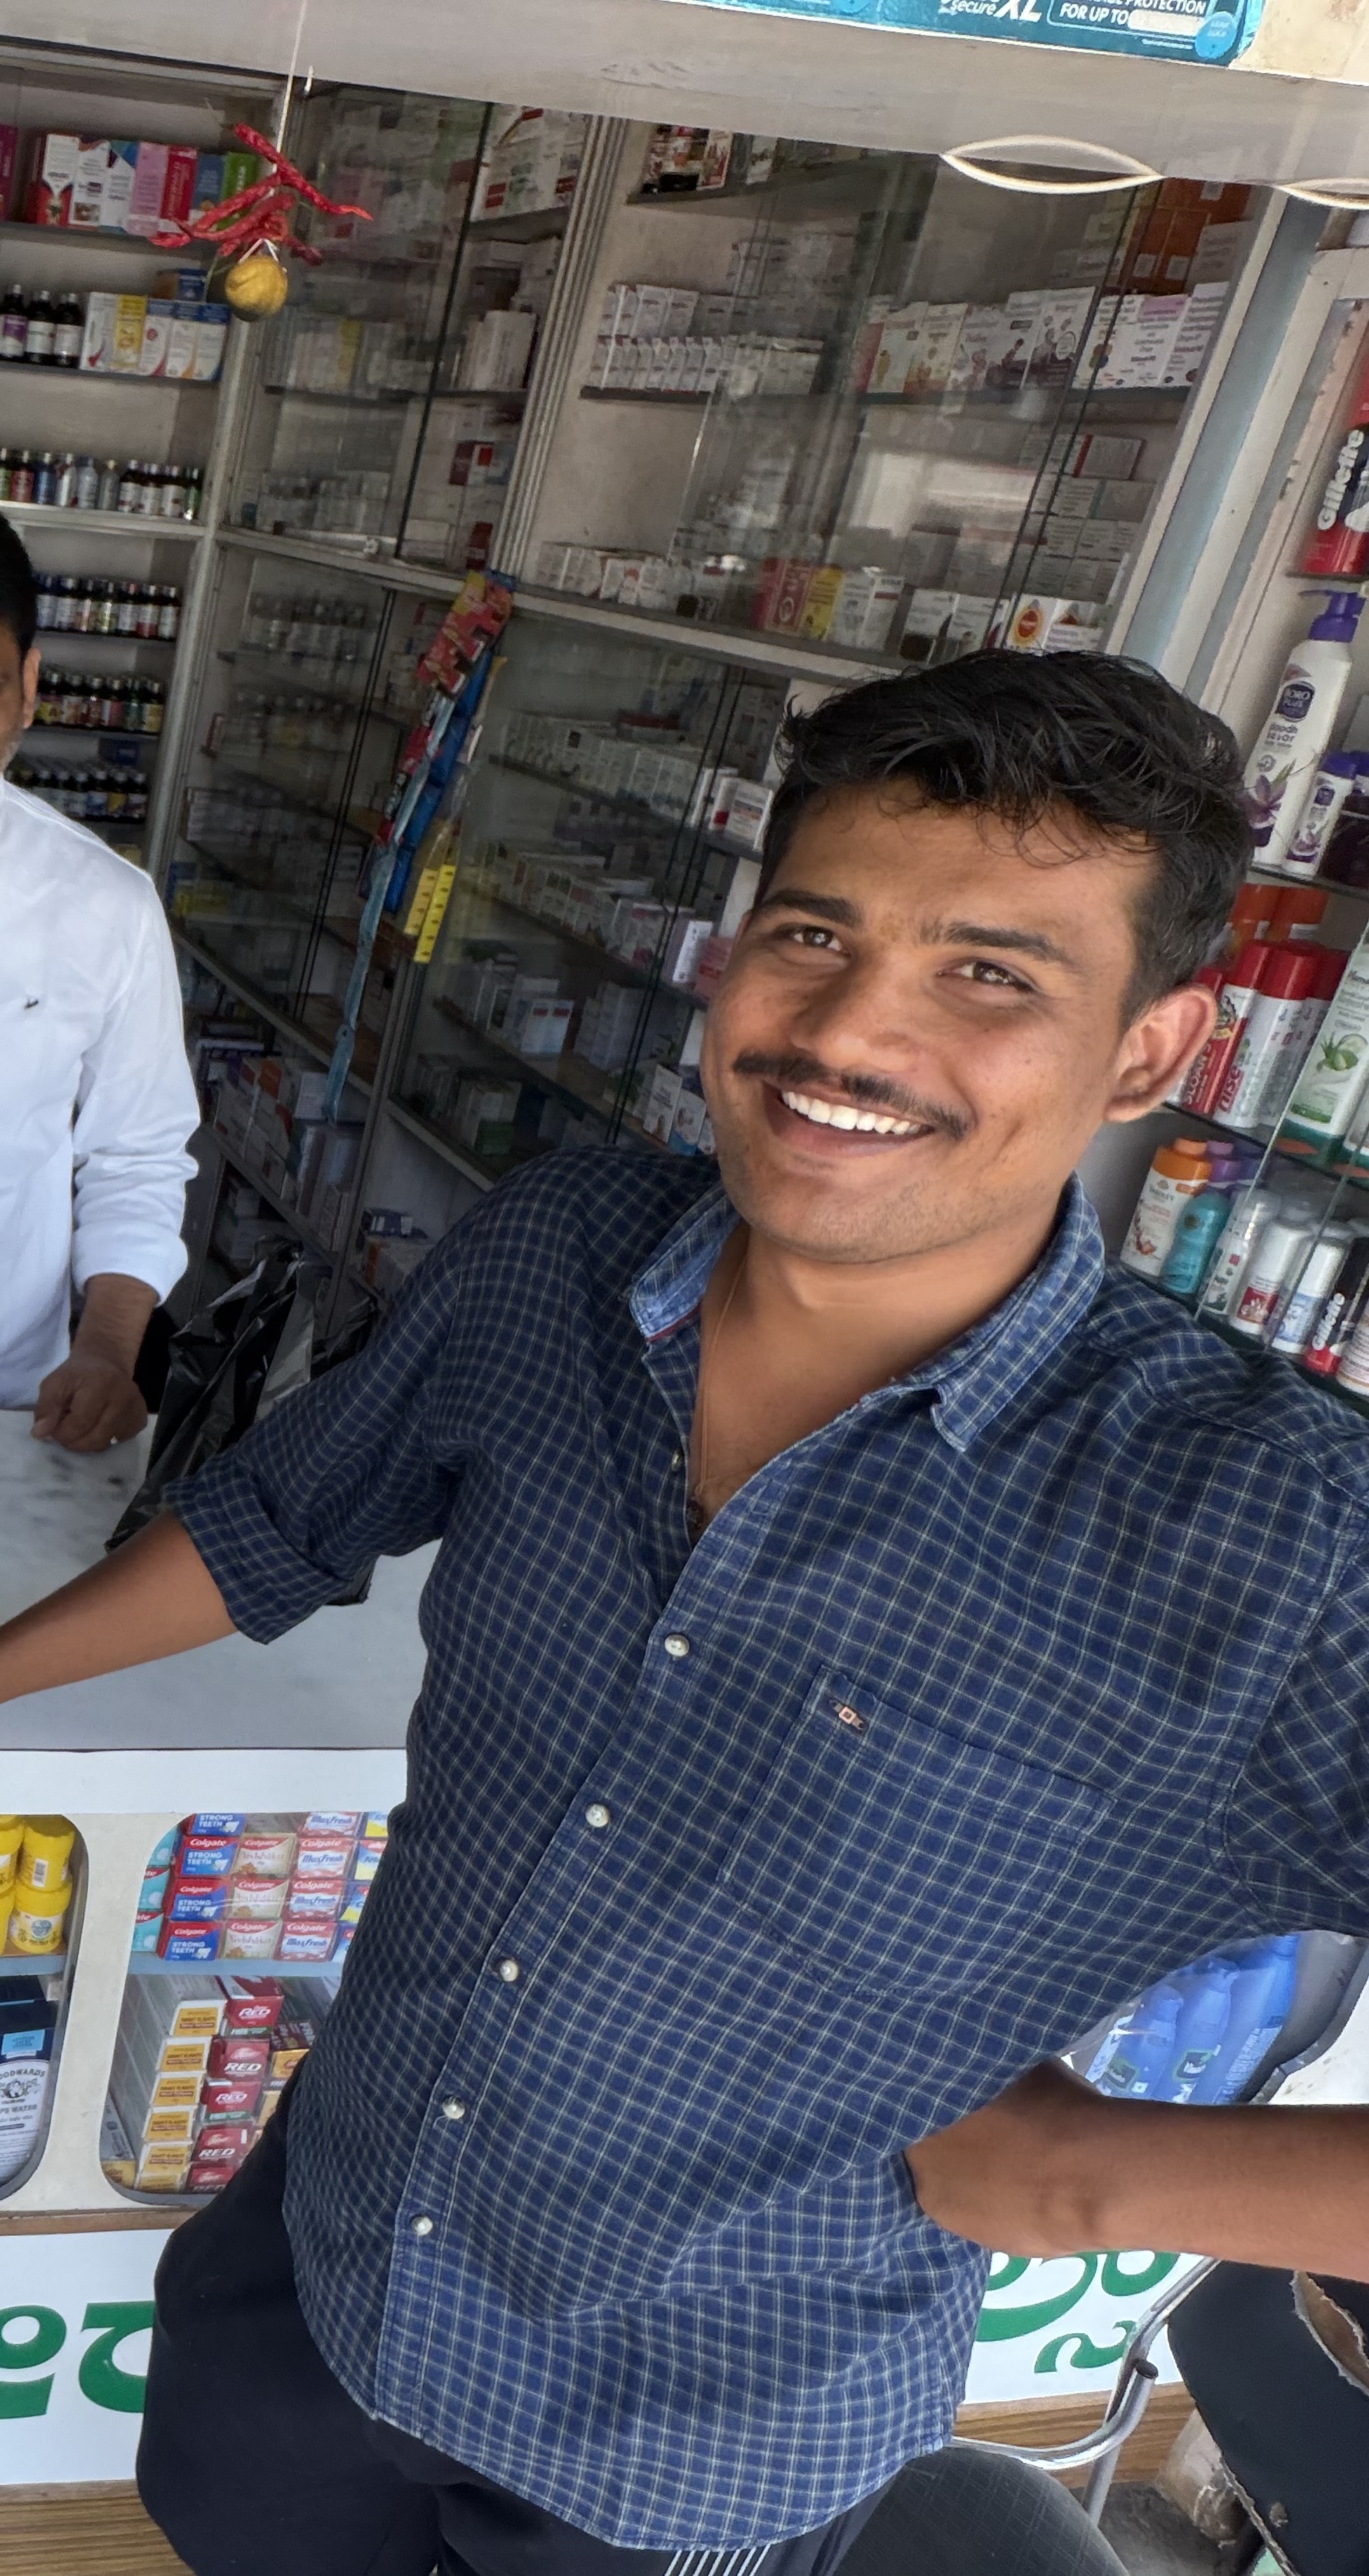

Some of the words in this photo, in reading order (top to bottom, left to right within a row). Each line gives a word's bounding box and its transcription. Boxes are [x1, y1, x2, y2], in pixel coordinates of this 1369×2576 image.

[1060, 6, 1086, 19] FOR
[1087, 10, 1108, 22] UP
[1109, 12, 1128, 25] TO
[1318, 429, 1365, 530] Gillette
[1311, 1292, 1346, 1350] Gillette
[190, 1838, 227, 1846] Colgate
[301, 1839, 342, 1848] Colgate
[302, 1854, 344, 1863] MaxFresh
[238, 1881, 274, 1890] Colgate
[294, 1881, 334, 1890] Colgate
[295, 1896, 337, 1905] MaxFresh
[231, 1922, 268, 1931] Colgate
[287, 1922, 326, 1932] Colgate
[286, 1938, 328, 1947] MaxFresh
[238, 2007, 271, 2018] RED
[224, 2062, 262, 2071] RED
[216, 2092, 247, 2102] RED
[199, 2147, 235, 2156] RED
